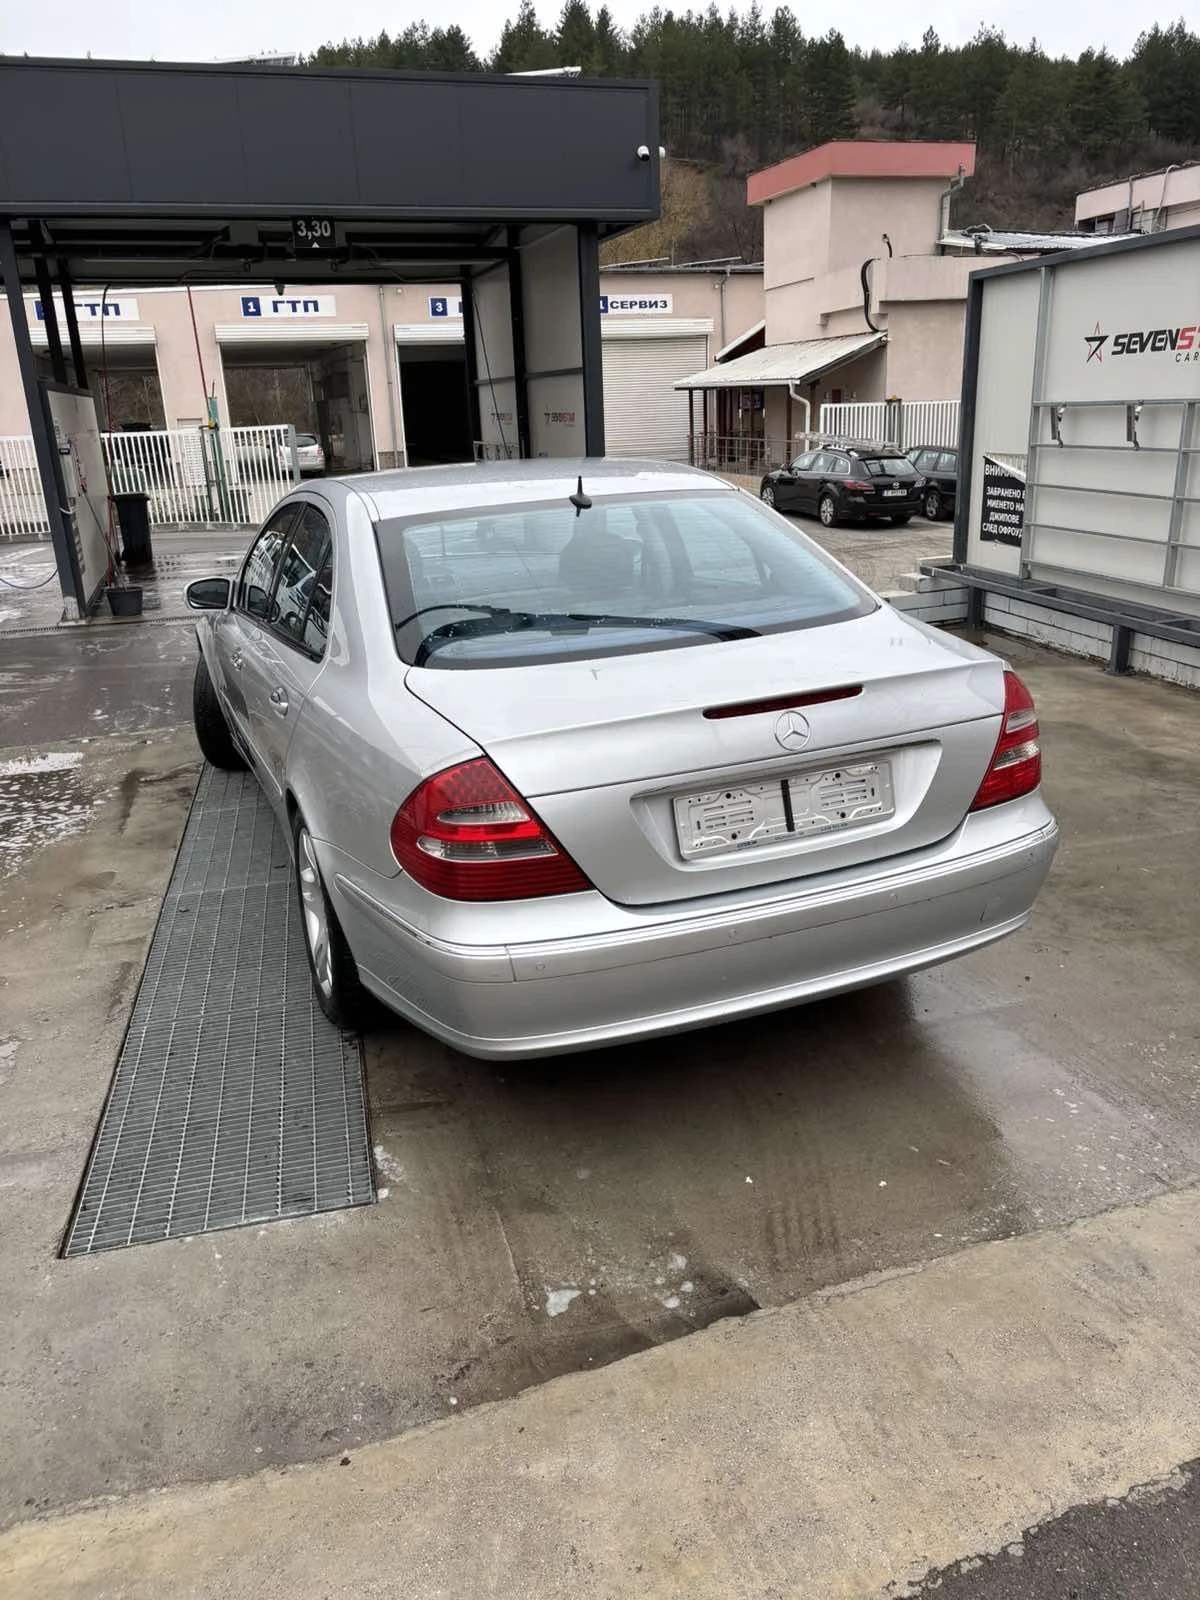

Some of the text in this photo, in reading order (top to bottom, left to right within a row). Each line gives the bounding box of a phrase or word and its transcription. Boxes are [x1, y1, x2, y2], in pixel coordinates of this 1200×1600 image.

[296, 220, 331, 240] 3,30
[247, 300, 319, 313] 1 ГТП
[435, 302, 444, 313] 3
[609, 300, 668, 310] СЕРВИЗ
[1111, 326, 1200, 356] SEVENS
[986, 486, 1021, 499] ЗАБРАНЕНО
[986, 499, 1025, 512] МИЕНЕТО НА
[989, 511, 1020, 524] ДЖИПОВЕ
[982, 522, 998, 534] СЛЕД
